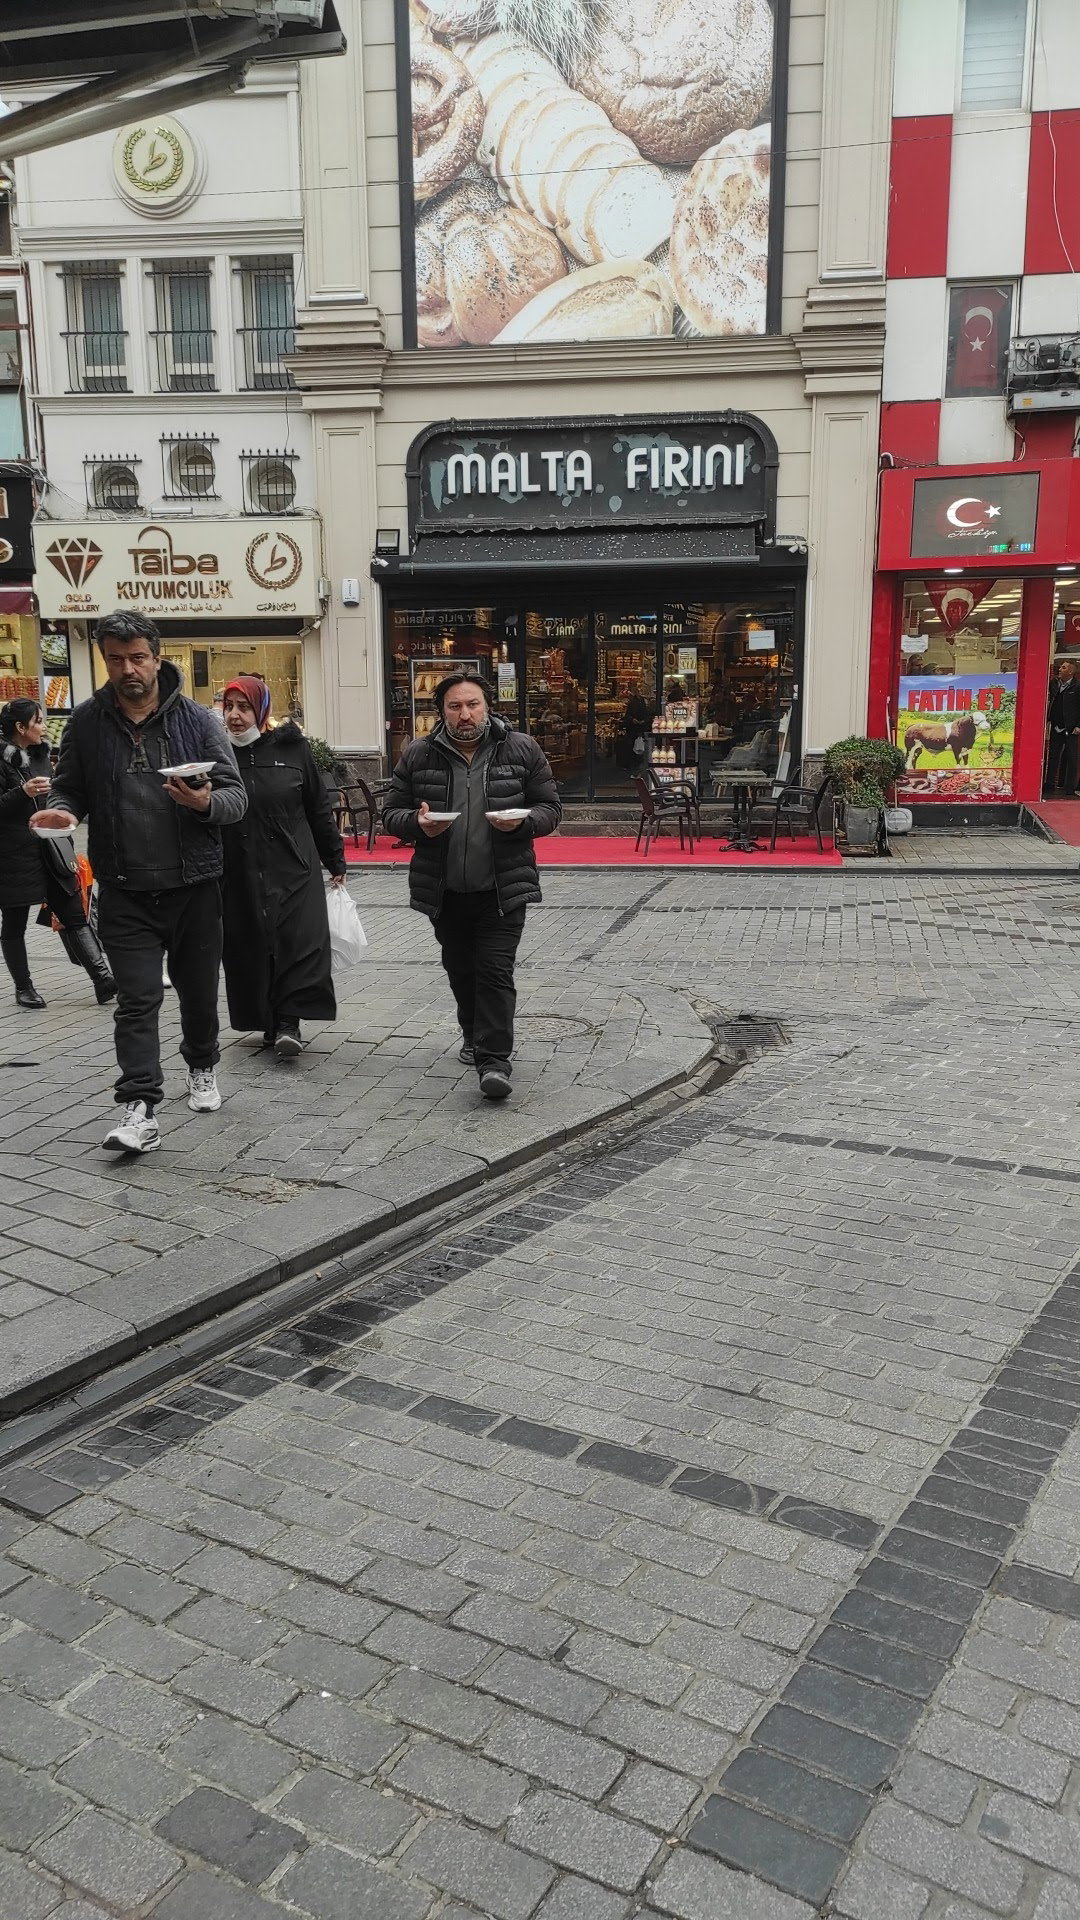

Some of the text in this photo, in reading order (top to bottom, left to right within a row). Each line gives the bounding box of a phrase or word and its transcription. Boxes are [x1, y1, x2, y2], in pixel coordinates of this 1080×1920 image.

[448, 450, 593, 494] MALTA
[127, 525, 219, 576] Taiba
[65, 594, 92, 603] GOLD
[117, 580, 233, 600] KUYUMCULUK
[59, 604, 100, 612] JEWELLERY
[611, 623, 683, 635] MALTA FRINI
[908, 685, 1006, 712] FATİH ET
